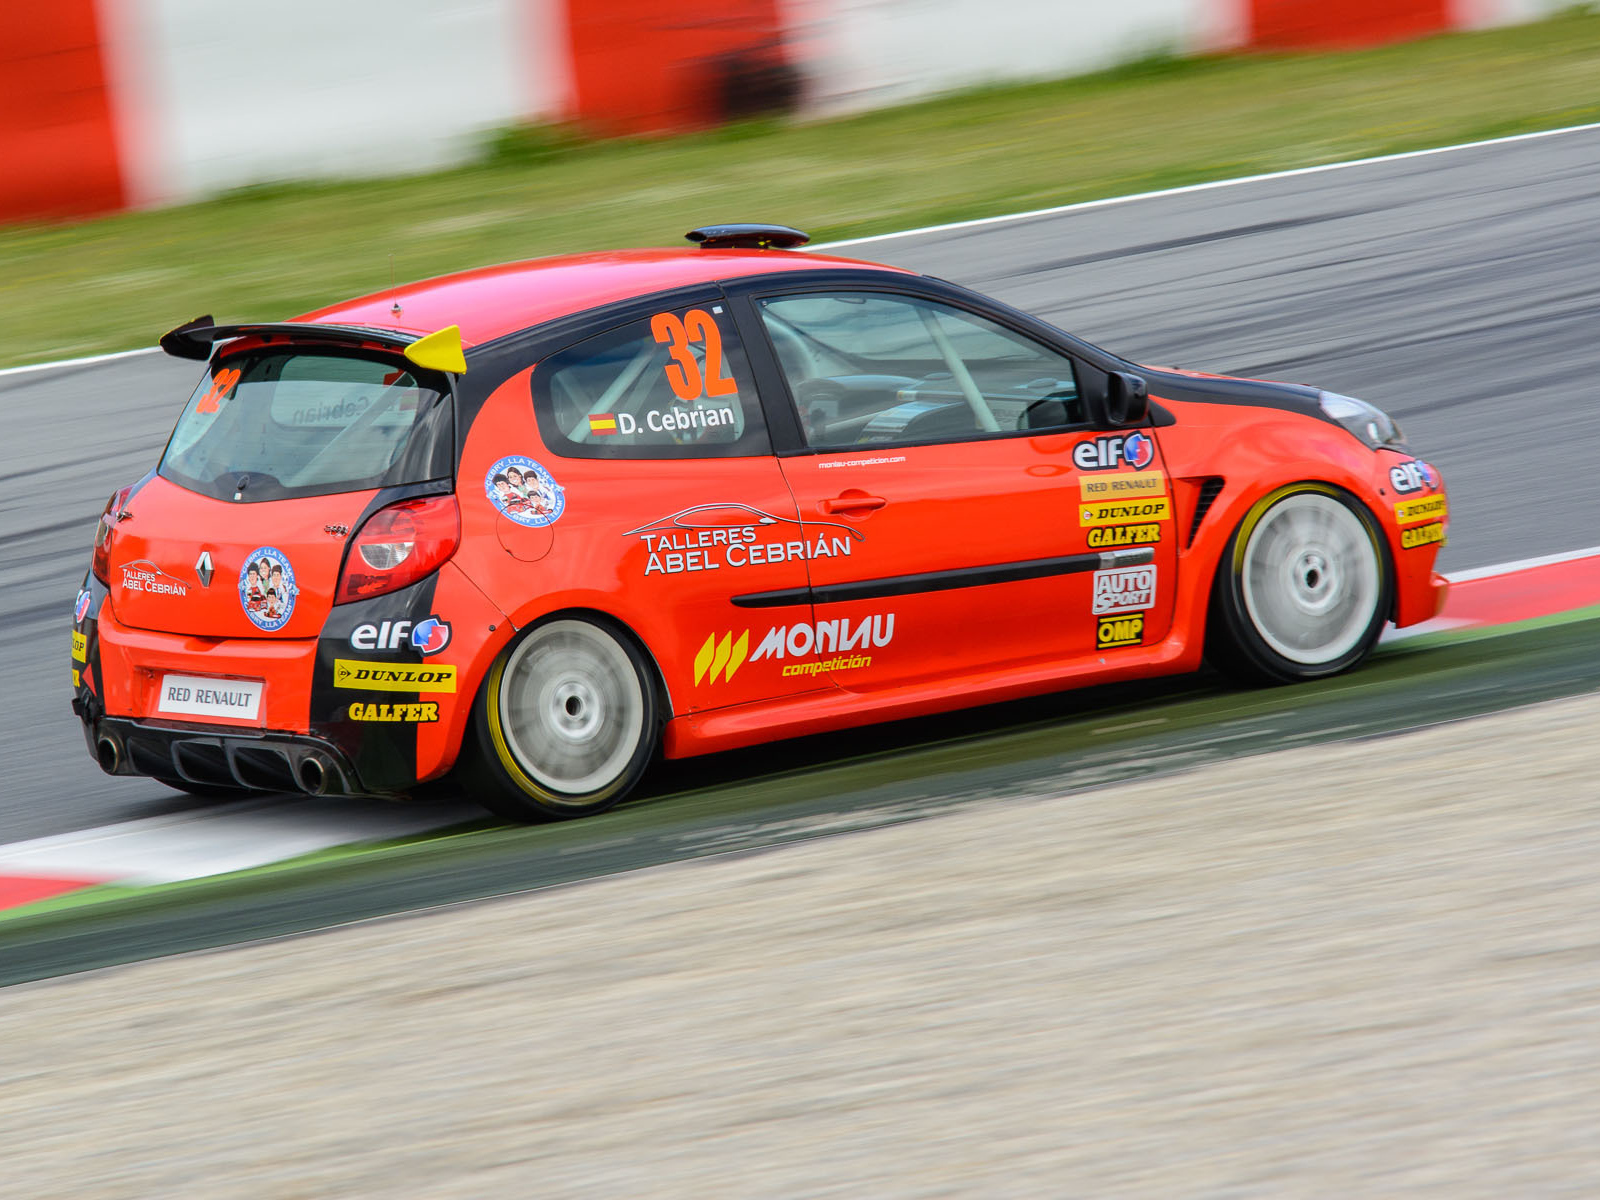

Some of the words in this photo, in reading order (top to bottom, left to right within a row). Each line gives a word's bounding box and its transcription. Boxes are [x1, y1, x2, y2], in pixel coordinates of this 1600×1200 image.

[651, 309, 738, 400] 32
[618, 413, 643, 434] D.
[647, 405, 734, 432] Cebrian
[1074, 438, 1123, 468] elf
[1086, 482, 1108, 493] RED
[1112, 478, 1157, 491] RENAULT
[1097, 504, 1165, 519] DUNLOP
[640, 527, 757, 553] TALLERES
[1088, 524, 1160, 547] GALFER
[644, 550, 720, 576] ABEL
[726, 532, 852, 568] CEBRIÁN
[123, 569, 155, 582] TALLERES
[123, 577, 143, 591] ABEL
[145, 580, 186, 596] CEBRIÁN
[1098, 572, 1151, 595] AUTO
[1095, 590, 1150, 613] SPORT
[351, 621, 412, 649] elf
[749, 613, 895, 662] MONLAU
[1098, 619, 1143, 643] OMP
[354, 669, 453, 683] DUNLOP
[782, 655, 872, 677] competición
[168, 687, 191, 702] RED
[195, 689, 252, 707] RENAULT
[348, 702, 439, 721] GALFER
